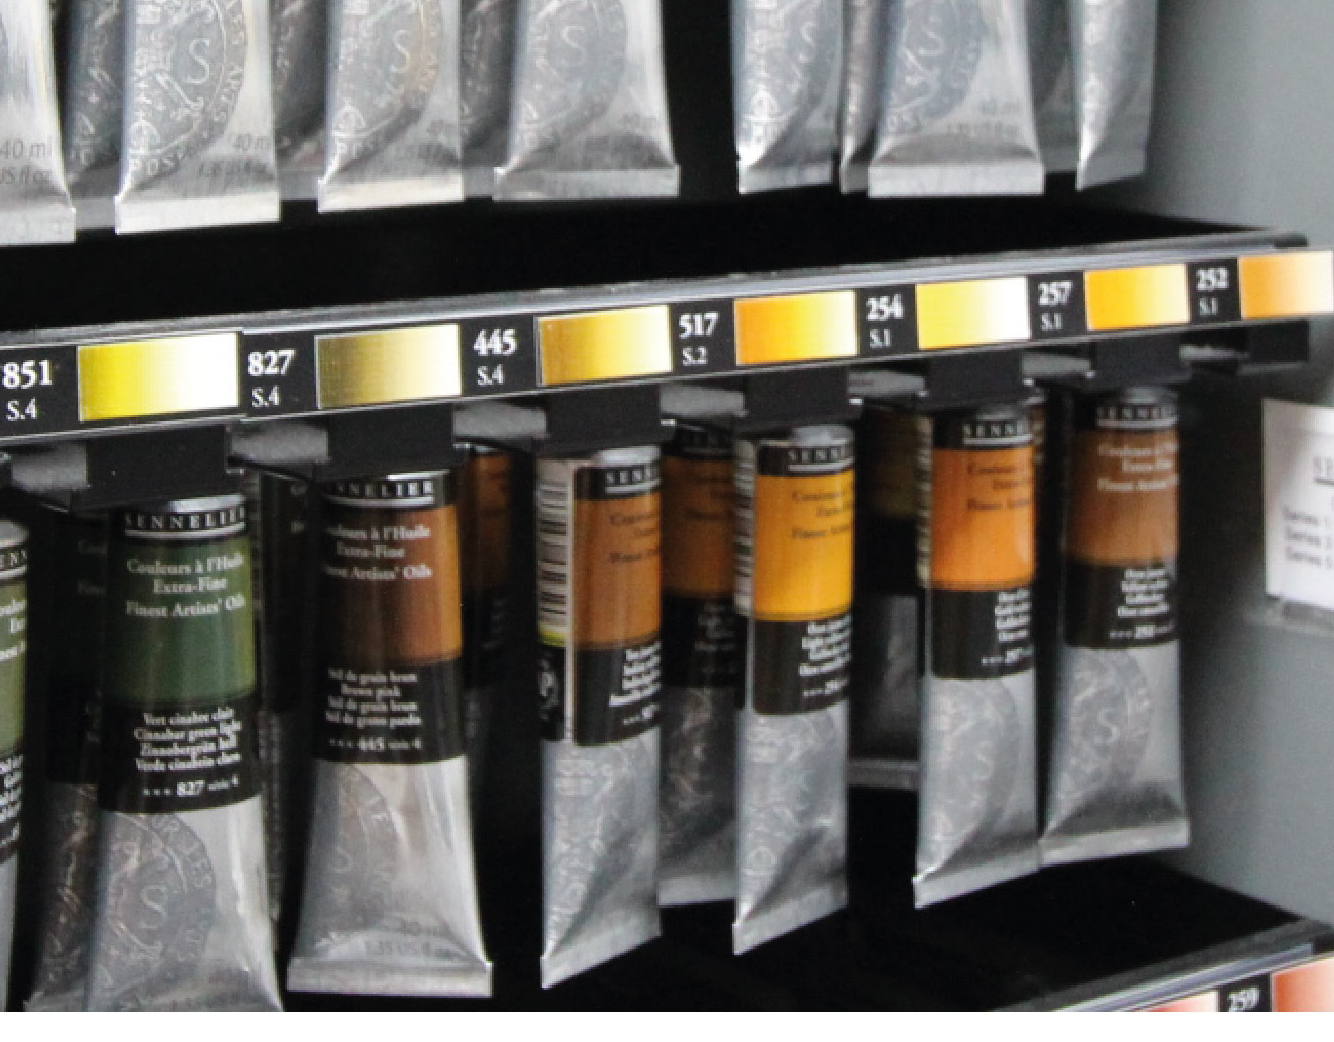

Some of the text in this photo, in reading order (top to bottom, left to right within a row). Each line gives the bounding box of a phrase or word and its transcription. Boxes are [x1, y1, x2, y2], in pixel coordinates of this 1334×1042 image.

[1037, 282, 1072, 307] 257
[866, 296, 905, 322] 254
[678, 312, 719, 338] 517
[869, 327, 892, 348] S.1
[473, 330, 518, 356] 445
[683, 343, 708, 366] S.2
[1, 361, 53, 390] 851
[248, 350, 295, 378] 827
[477, 367, 506, 387] S.4
[252, 386, 281, 408] S.4
[6, 399, 39, 422] S.4
